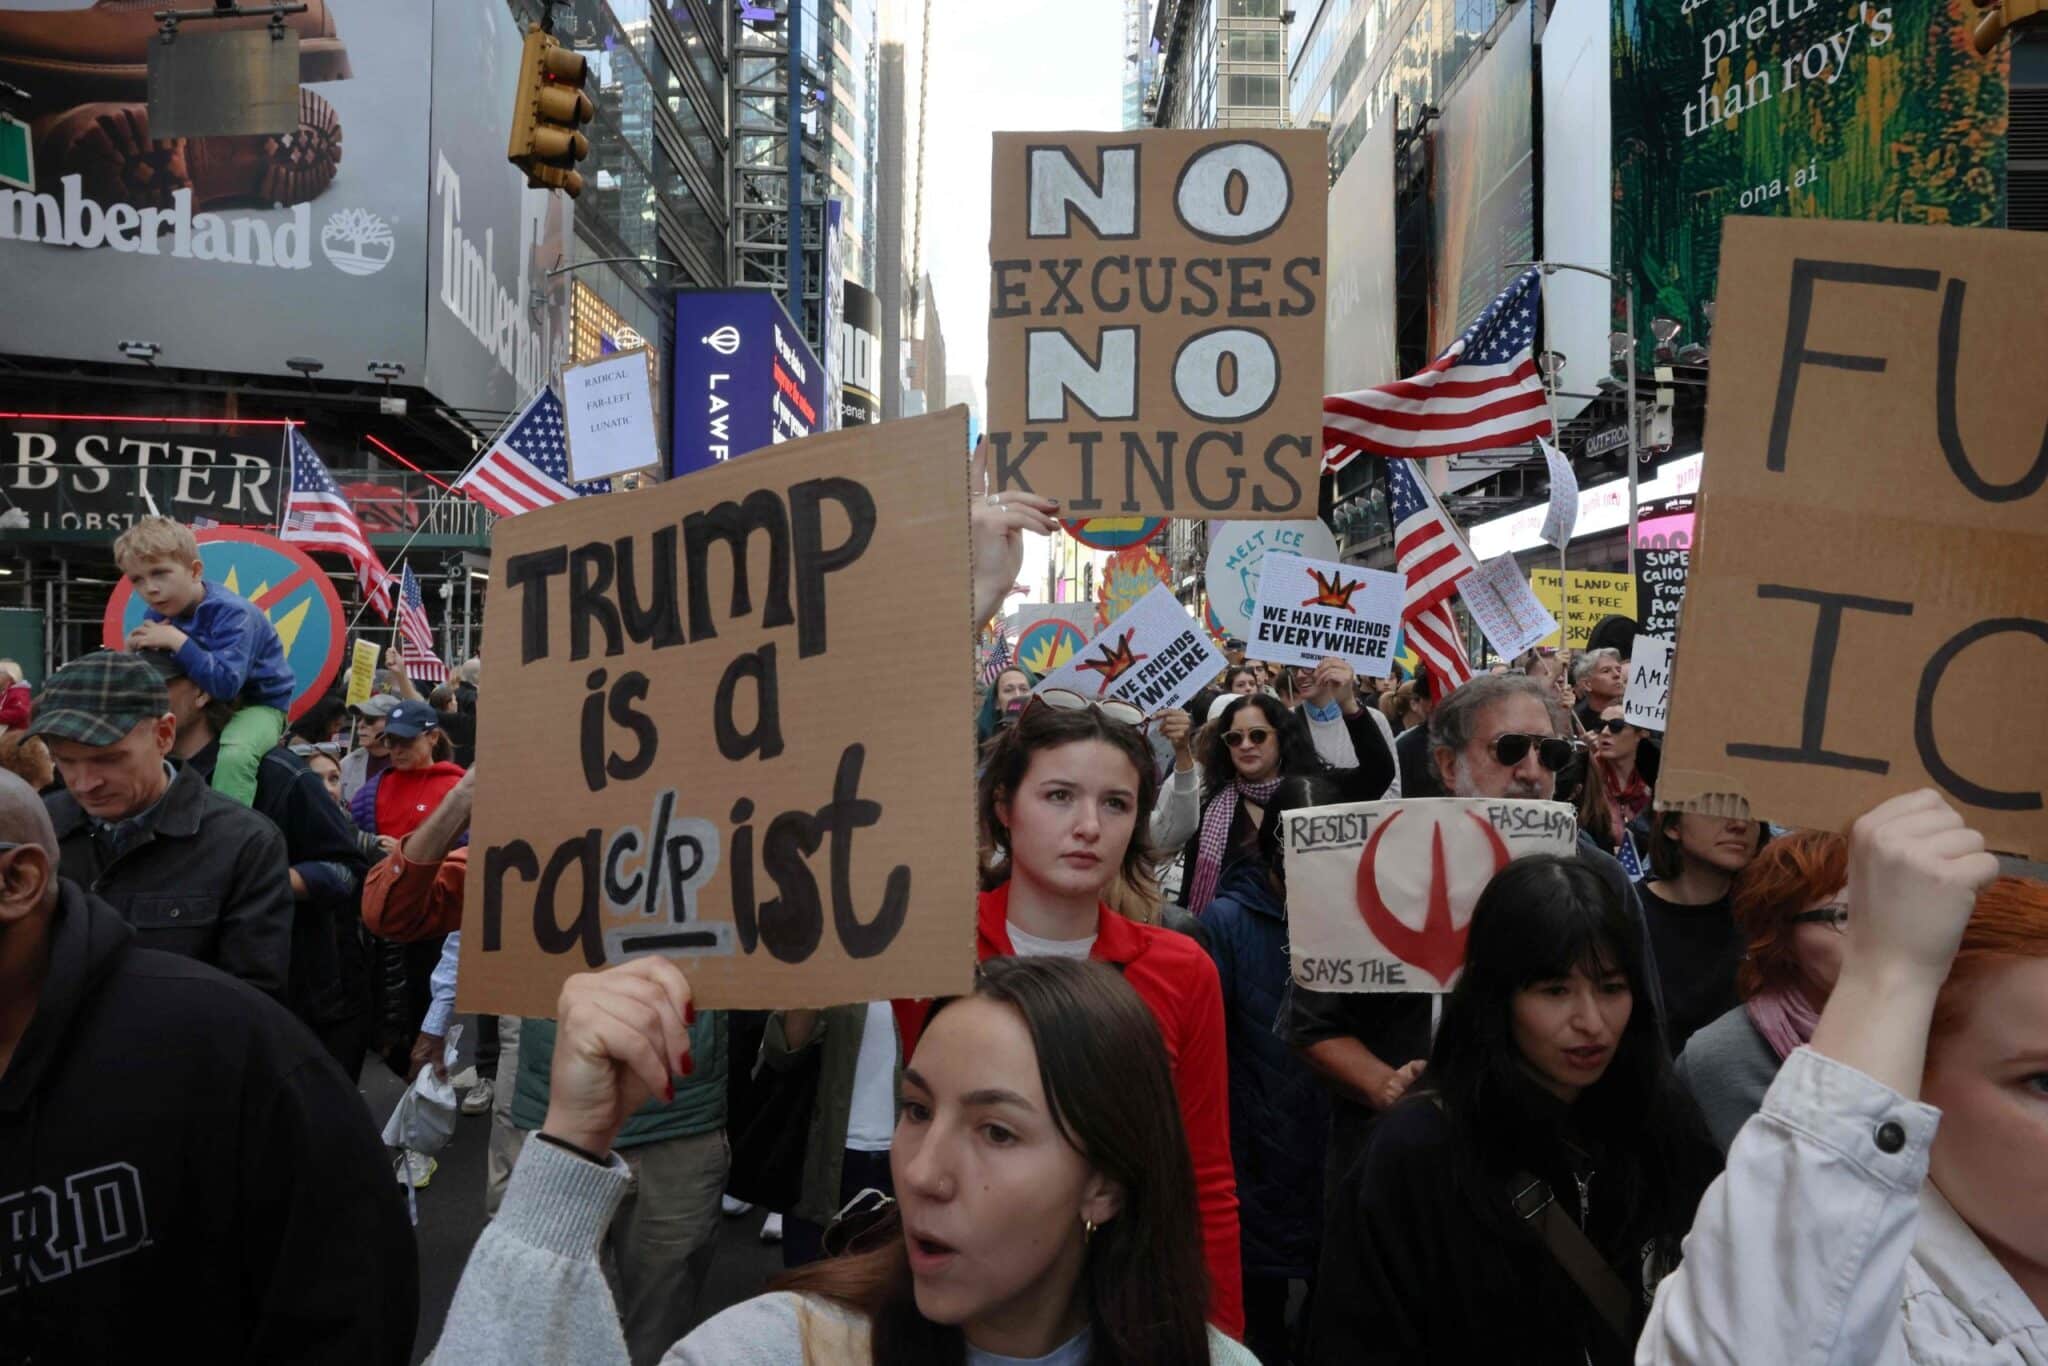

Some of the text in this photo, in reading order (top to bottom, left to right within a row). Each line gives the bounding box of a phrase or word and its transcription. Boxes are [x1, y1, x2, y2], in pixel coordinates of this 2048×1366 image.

[1682, 1, 1893, 137] than roy's
[1026, 138, 1294, 245] NO
[1740, 158, 1818, 208] ona.ai
[0, 174, 312, 270] mberland
[990, 255, 1321, 319] EXCUSES
[584, 370, 628, 388] RADICAL
[1025, 324, 1281, 425] NO
[1766, 258, 2048, 503] FU
[586, 391, 633, 411] FAR-LEFT
[590, 416, 633, 433] LUNATIC
[708, 374, 730, 461] LAWF
[9, 431, 273, 516] BSTER
[989, 431, 1313, 513] KINGS
[1225, 529, 1304, 570] MELT ICE
[1574, 578, 1611, 590] LAND
[1614, 582, 1631, 592] OF
[1588, 596, 1622, 608] FREE
[1258, 622, 1388, 659] EVERYWHERE
[1263, 605, 1391, 638] WE HAVE FRIENDS
[1568, 611, 1584, 621] WE
[1136, 630, 1196, 684] FRIENDS
[580, 641, 784, 792] is a
[1291, 813, 1378, 847] RESIST
[1300, 958, 1407, 985] SAYS THE
